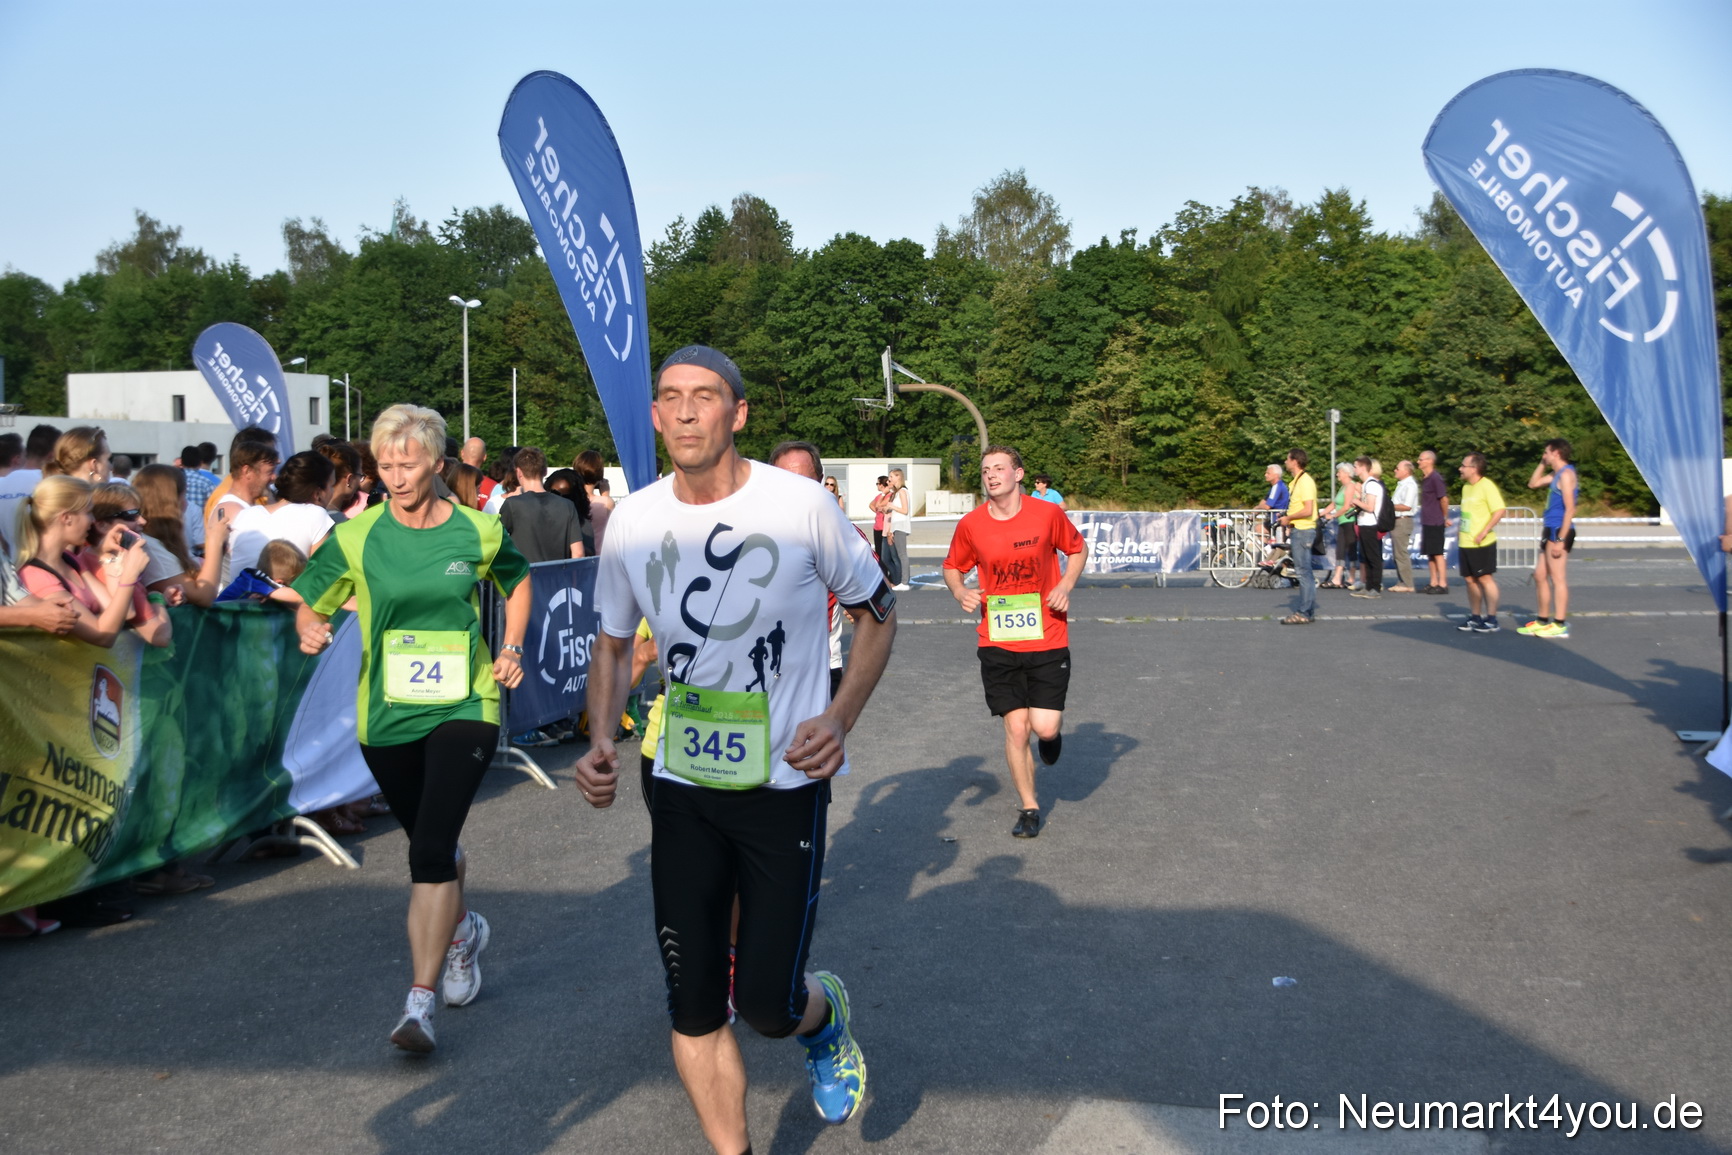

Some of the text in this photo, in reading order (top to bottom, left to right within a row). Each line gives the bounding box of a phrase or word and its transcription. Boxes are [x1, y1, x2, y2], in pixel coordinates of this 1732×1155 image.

[446, 561, 471, 573] AOK
[1085, 555, 1157, 565] AUTOMOBILE
[994, 612, 1037, 629] 1536
[558, 620, 600, 671] Fisc
[409, 660, 444, 684] 24
[562, 673, 588, 694] AUT
[683, 726, 747, 763] 345
[690, 763, 738, 776] Robert Mertens
